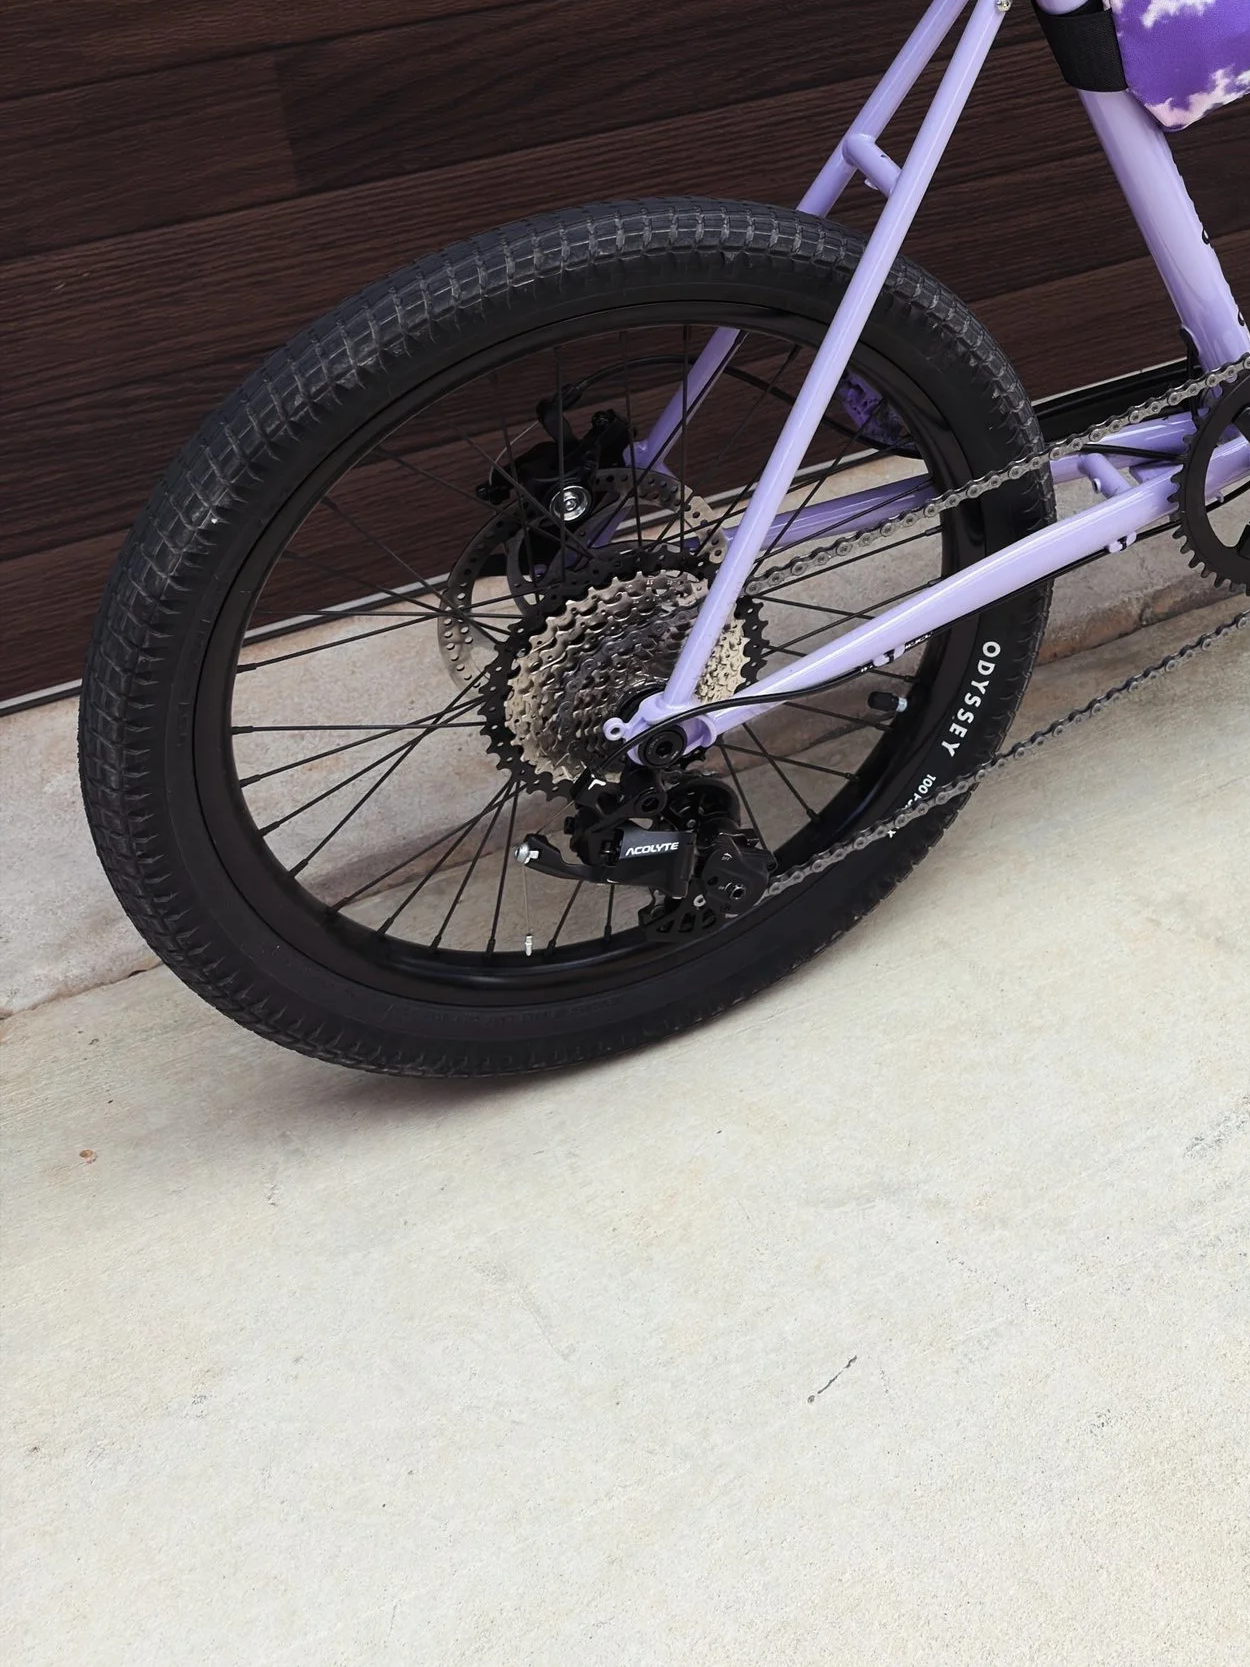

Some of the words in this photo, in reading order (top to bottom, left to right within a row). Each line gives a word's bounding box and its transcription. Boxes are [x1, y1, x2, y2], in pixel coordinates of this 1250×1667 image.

[941, 640, 1001, 757] ODYSSEY
[918, 773, 937, 795] 100
[625, 841, 680, 857] ACOLYTE
